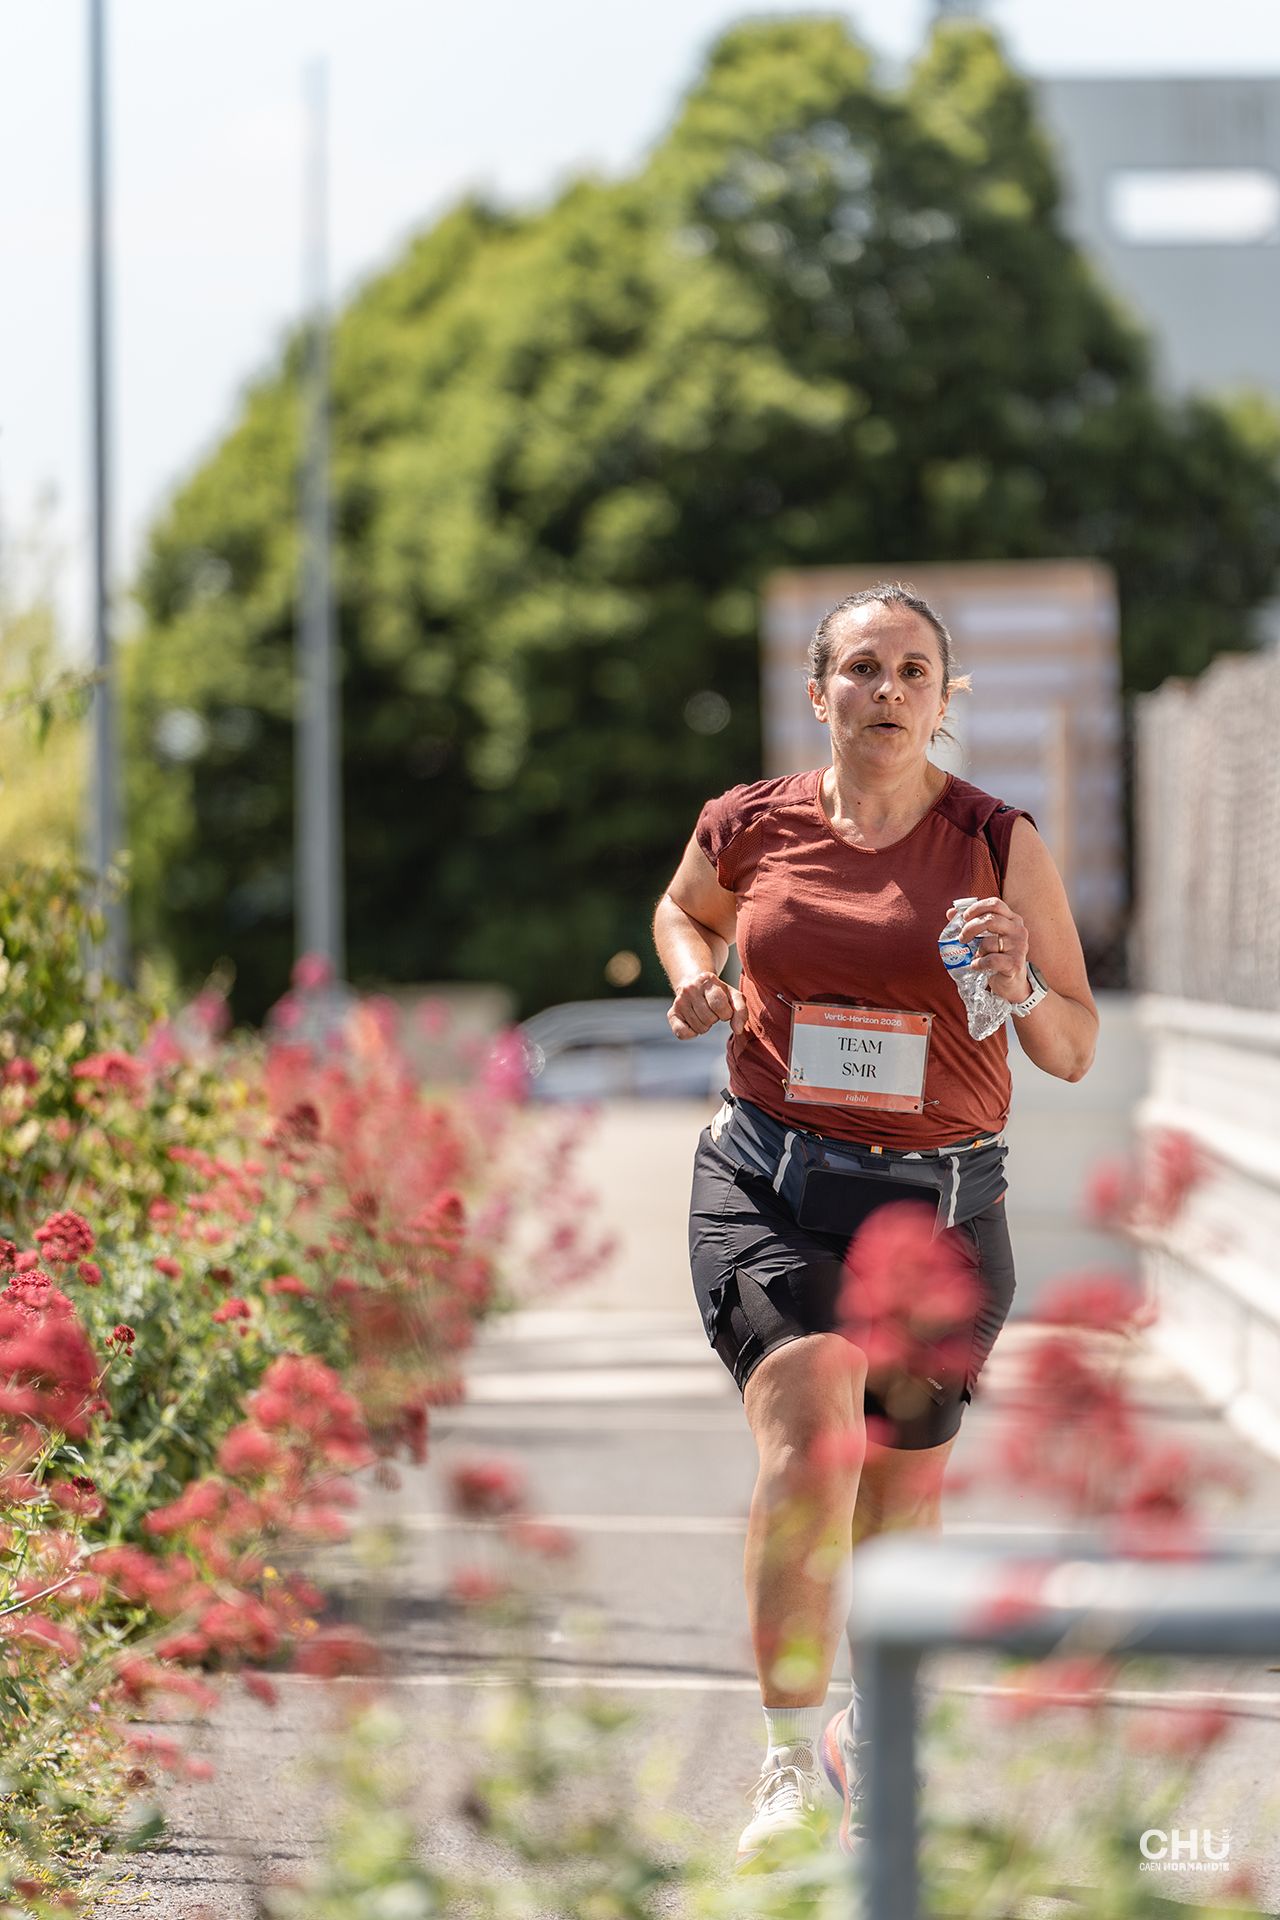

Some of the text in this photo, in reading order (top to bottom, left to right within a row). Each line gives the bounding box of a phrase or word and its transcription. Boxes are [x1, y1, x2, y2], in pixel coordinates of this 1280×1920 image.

[824, 1012, 880, 1025] Vertic-Horizon
[838, 1036, 883, 1055] TEAM
[841, 1061, 877, 1079] SMR
